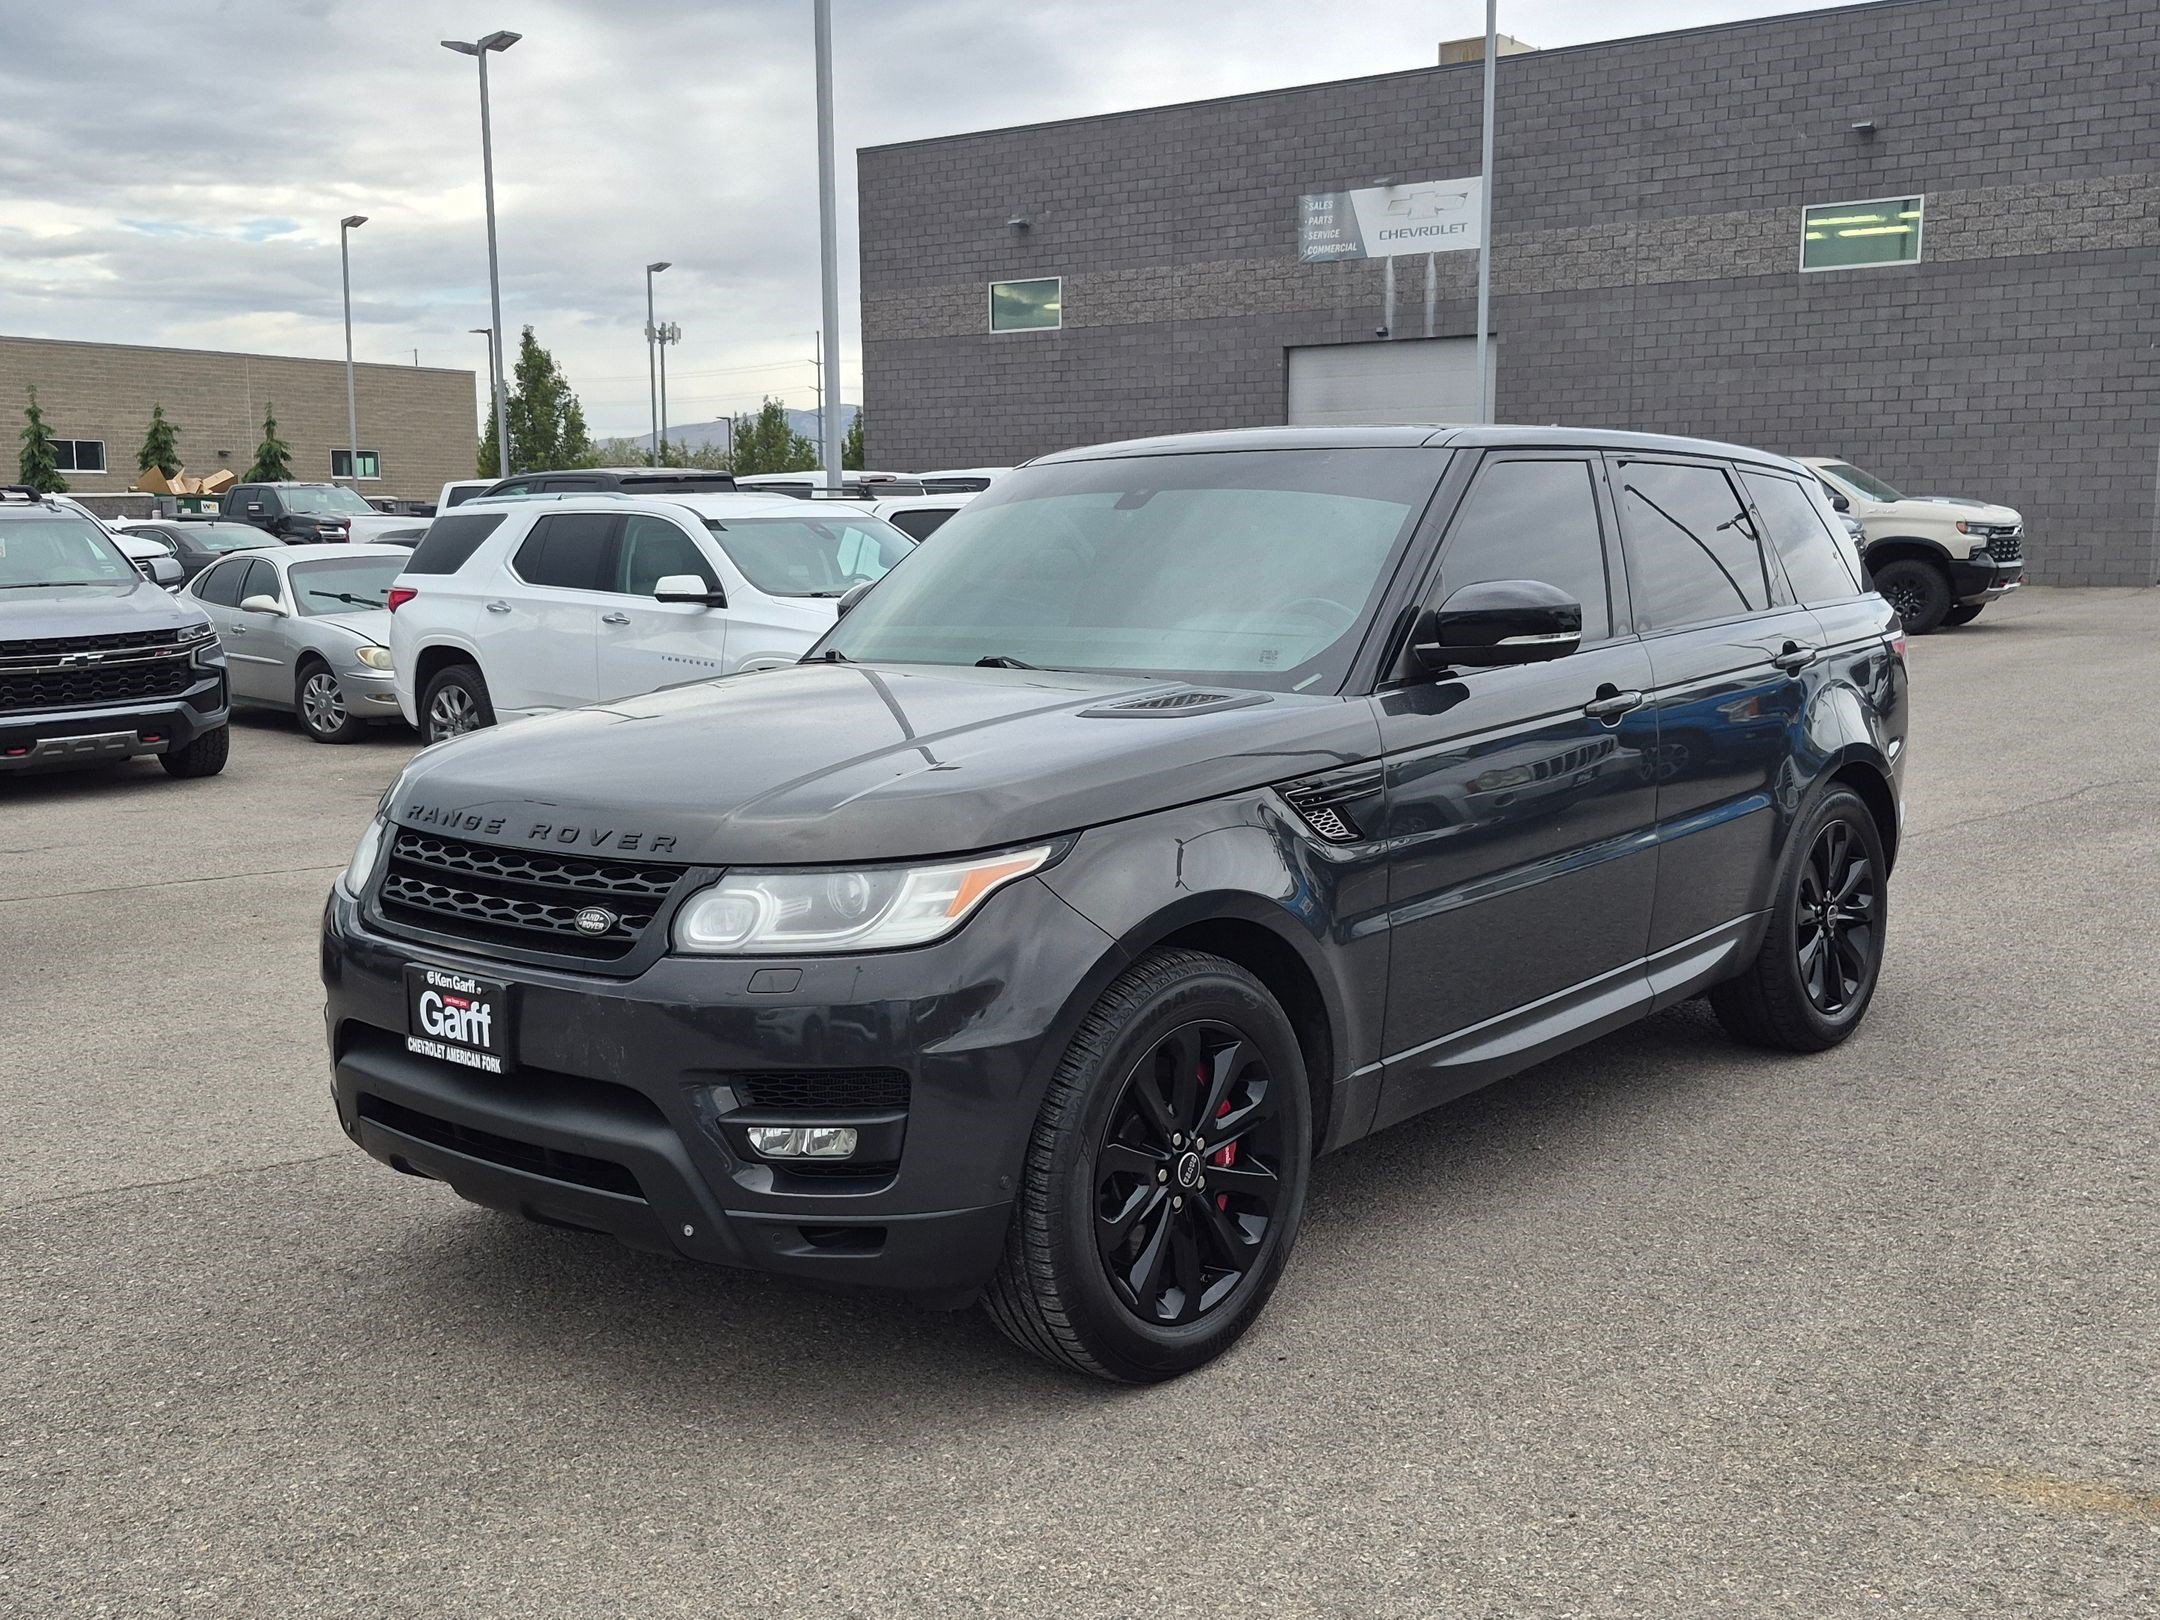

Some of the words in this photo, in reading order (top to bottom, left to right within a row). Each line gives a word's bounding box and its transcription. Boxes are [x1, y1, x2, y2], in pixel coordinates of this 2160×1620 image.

[1309, 200, 1333, 211] SALES
[1308, 215, 1333, 225] PARTS
[1308, 228, 1340, 240] SERVICE
[1379, 222, 1468, 241] CHEVROLET
[1307, 242, 1357, 255] COMMERCIAL
[406, 804, 506, 835] RANGE
[528, 823, 677, 853] ROVER
[581, 912, 600, 921] LAND
[581, 920, 605, 930] ROVER
[435, 972, 452, 989] Ken
[453, 976, 476, 993] Garff
[420, 990, 491, 1048] Garff
[408, 1036, 446, 1060] CHEVROLET
[446, 1046, 481, 1068] AMERICAN
[481, 1056, 501, 1074] FORK
